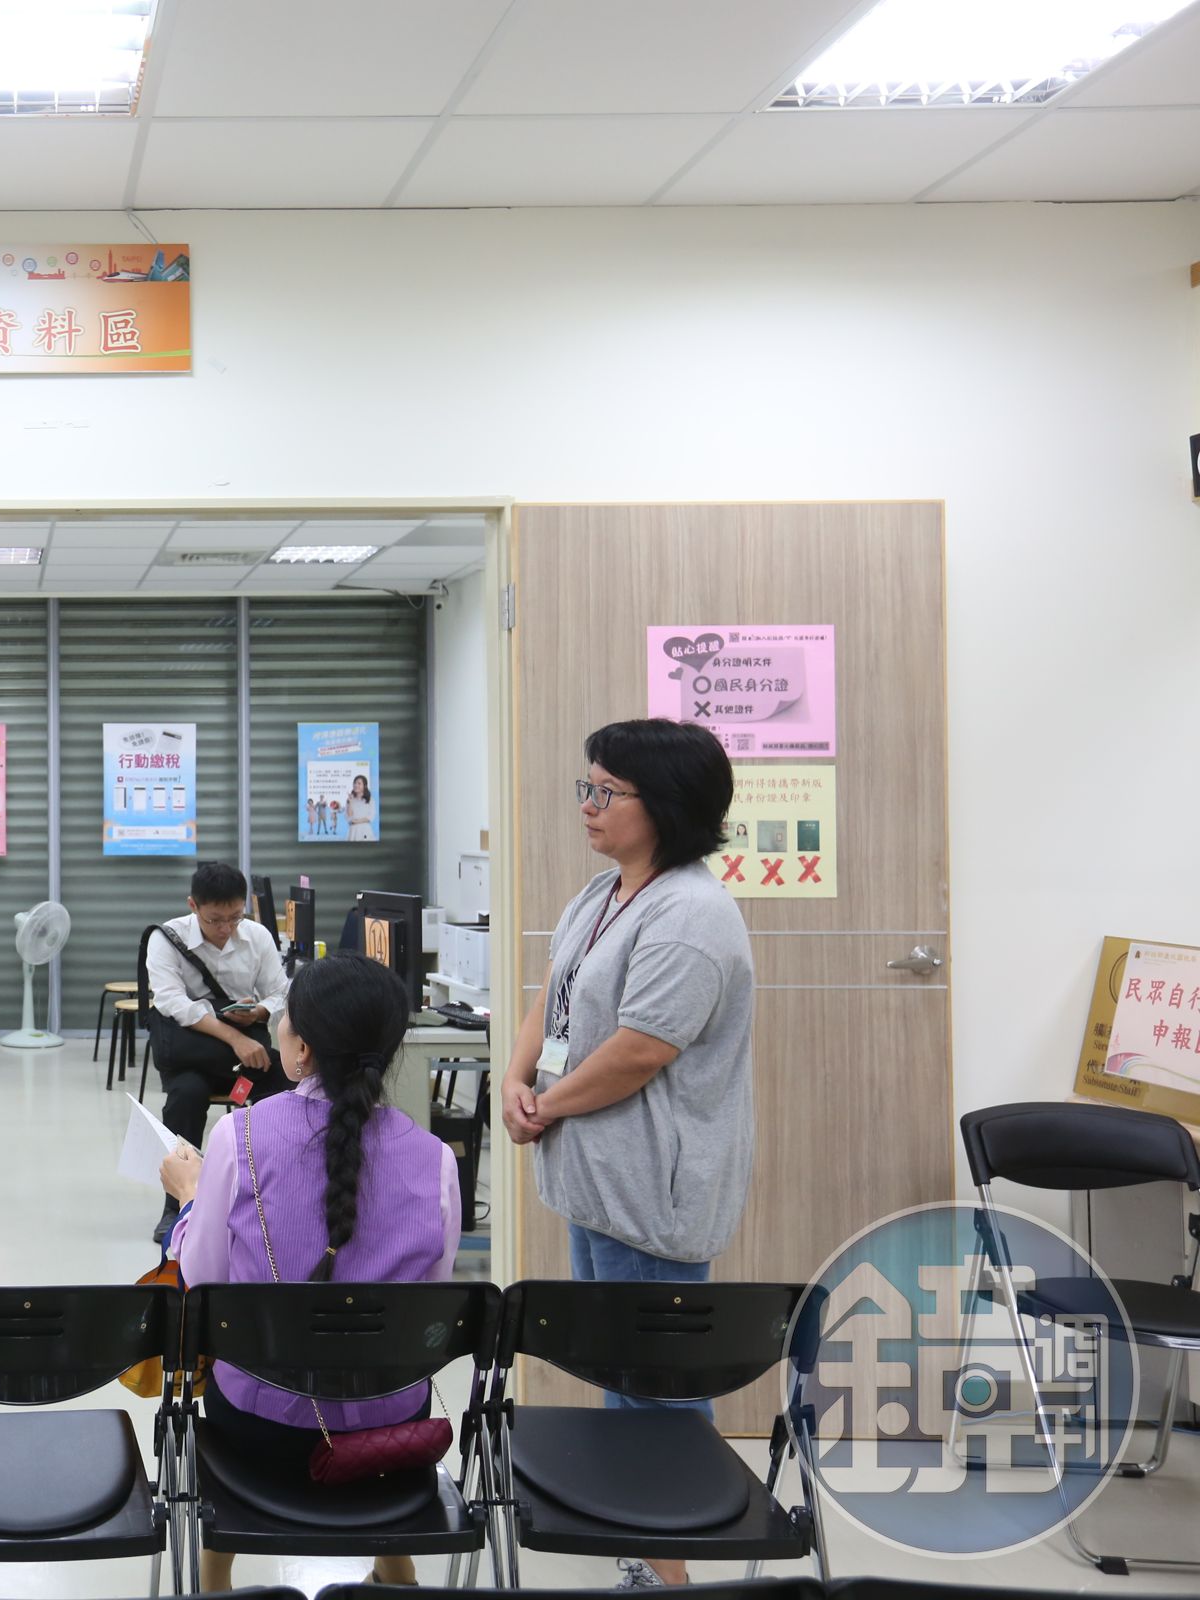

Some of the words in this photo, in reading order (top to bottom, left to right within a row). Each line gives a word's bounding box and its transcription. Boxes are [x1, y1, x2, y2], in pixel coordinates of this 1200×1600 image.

[713, 678, 789, 693] 國民身分證
[714, 704, 755, 715] 其他證件
[118, 753, 181, 769] 行動繳稅
[1152, 1018, 1200, 1053] 申報
